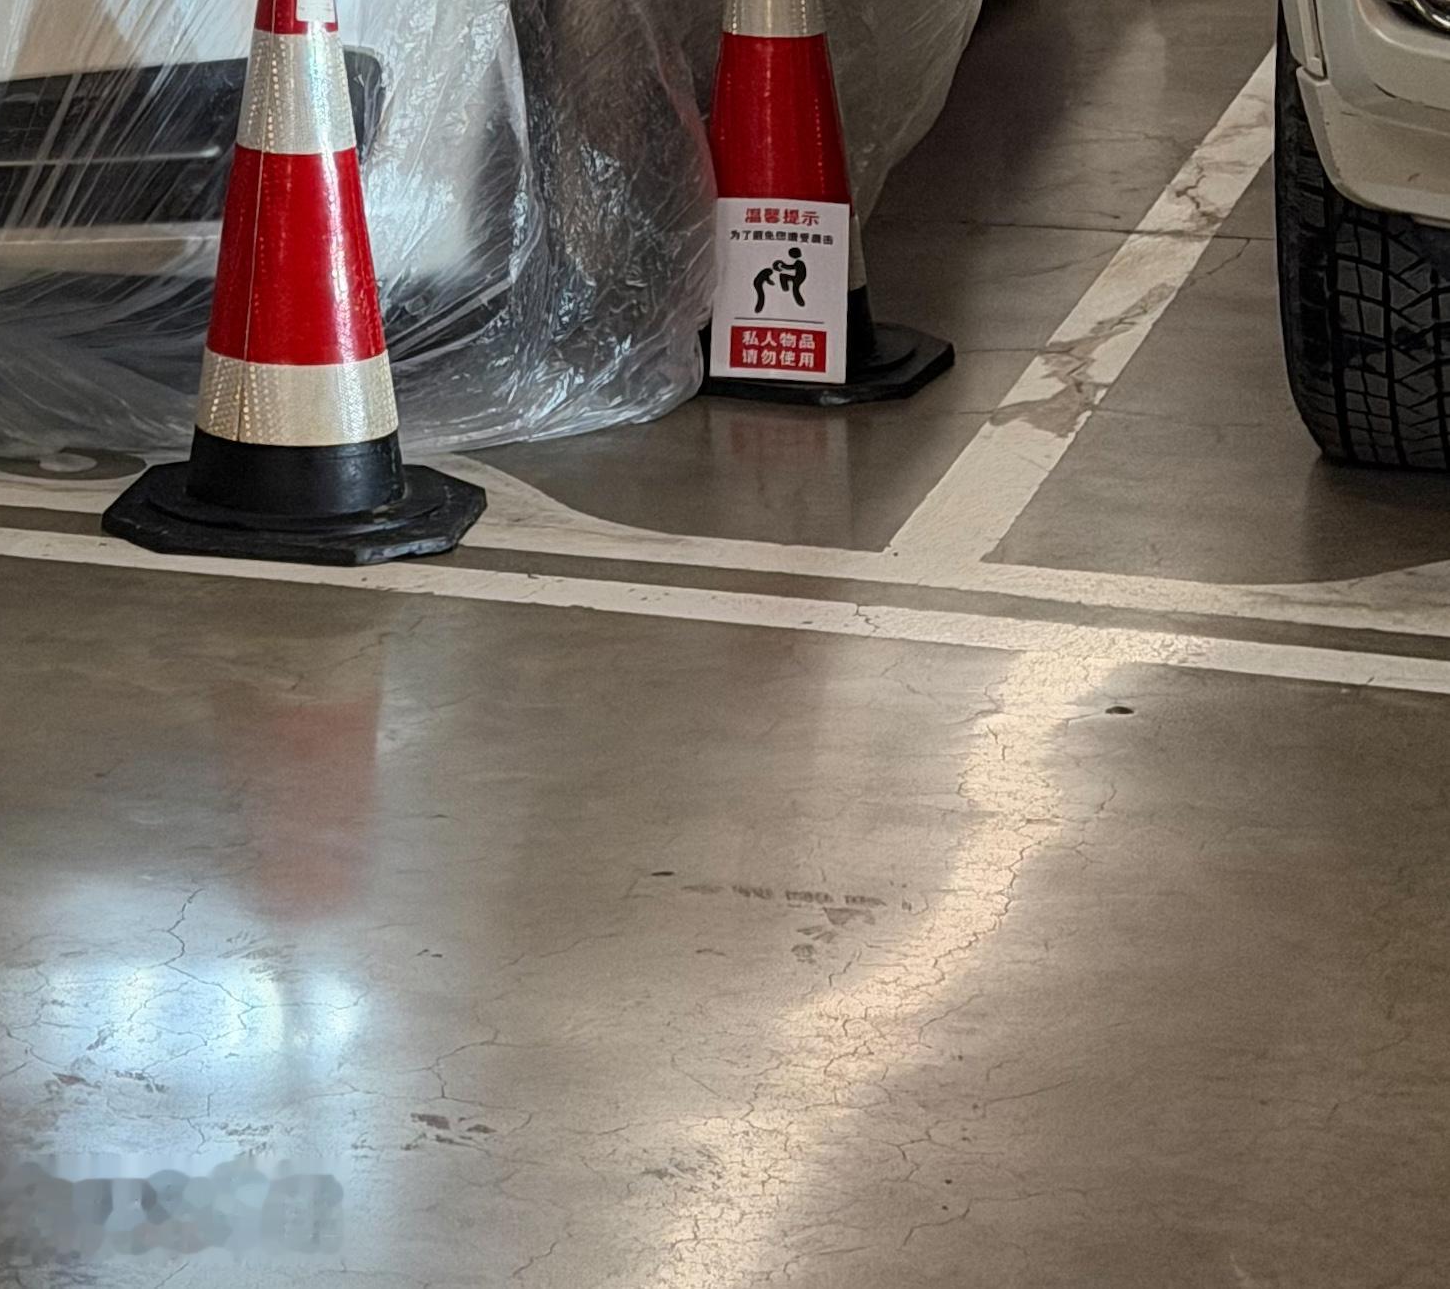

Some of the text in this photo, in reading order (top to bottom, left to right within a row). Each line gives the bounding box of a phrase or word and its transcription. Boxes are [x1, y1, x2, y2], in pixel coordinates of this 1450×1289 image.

[745, 208, 820, 226] 温馨提示
[742, 330, 816, 350] 私人物品
[742, 349, 816, 368] 请勿使用
